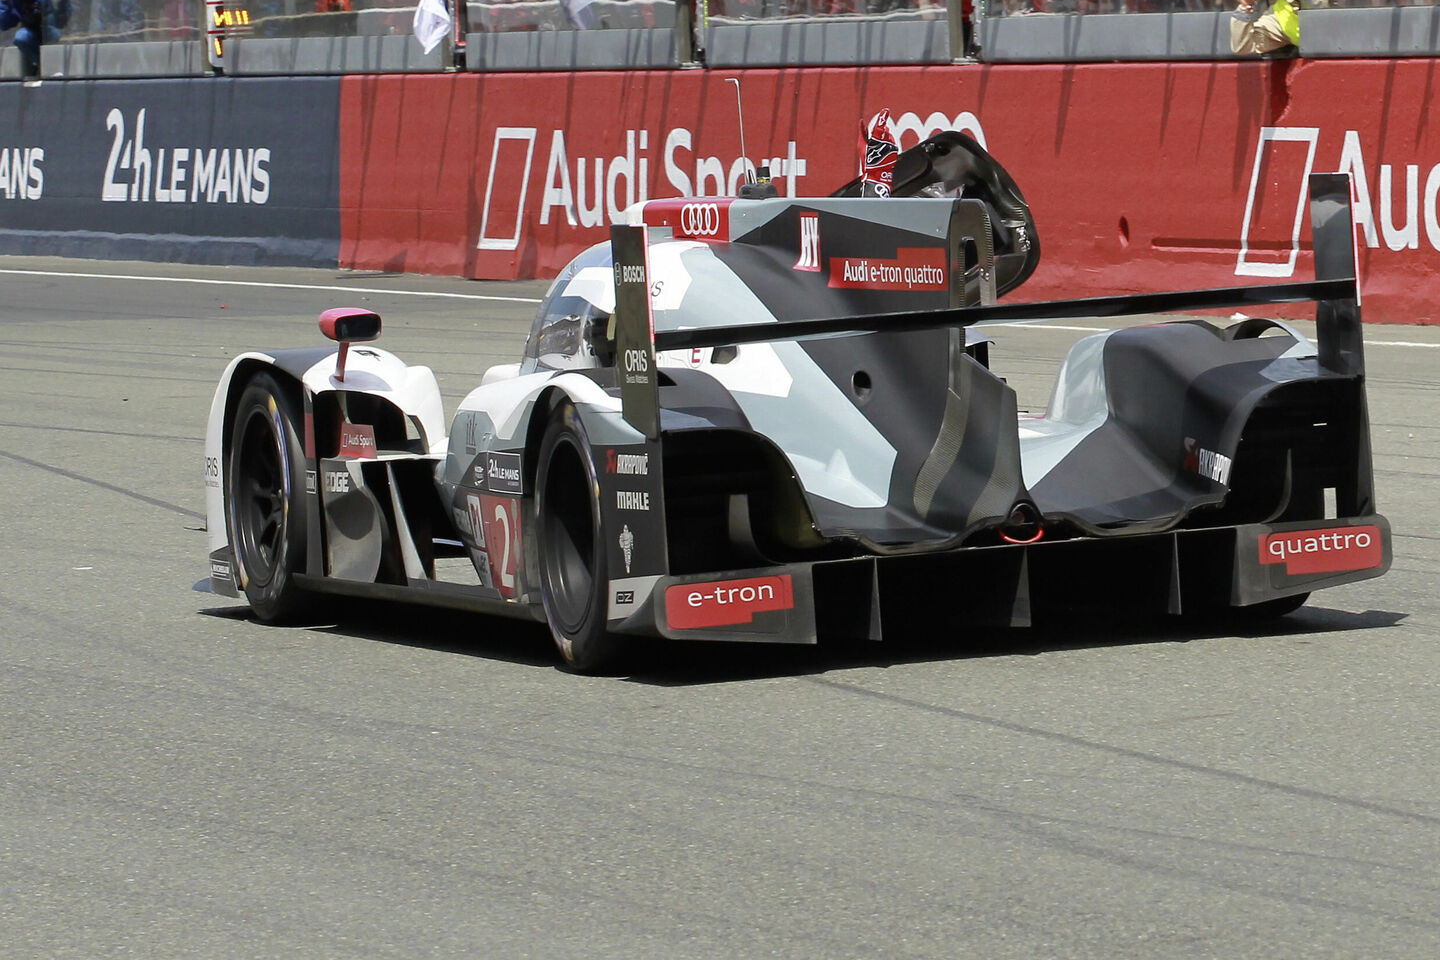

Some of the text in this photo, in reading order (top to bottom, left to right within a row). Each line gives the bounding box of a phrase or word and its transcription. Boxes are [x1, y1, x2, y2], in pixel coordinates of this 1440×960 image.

[102, 108, 271, 204] 24h LE MANS
[540, 129, 648, 228] Audi
[622, 265, 646, 283] BOSCH
[843, 260, 944, 289] Audi e-tron quattro
[624, 349, 648, 372] ORIS
[616, 490, 650, 511] MAHLE
[494, 504, 515, 589] 2
[1268, 531, 1372, 559] quattro
[687, 583, 775, 607] e-tron
